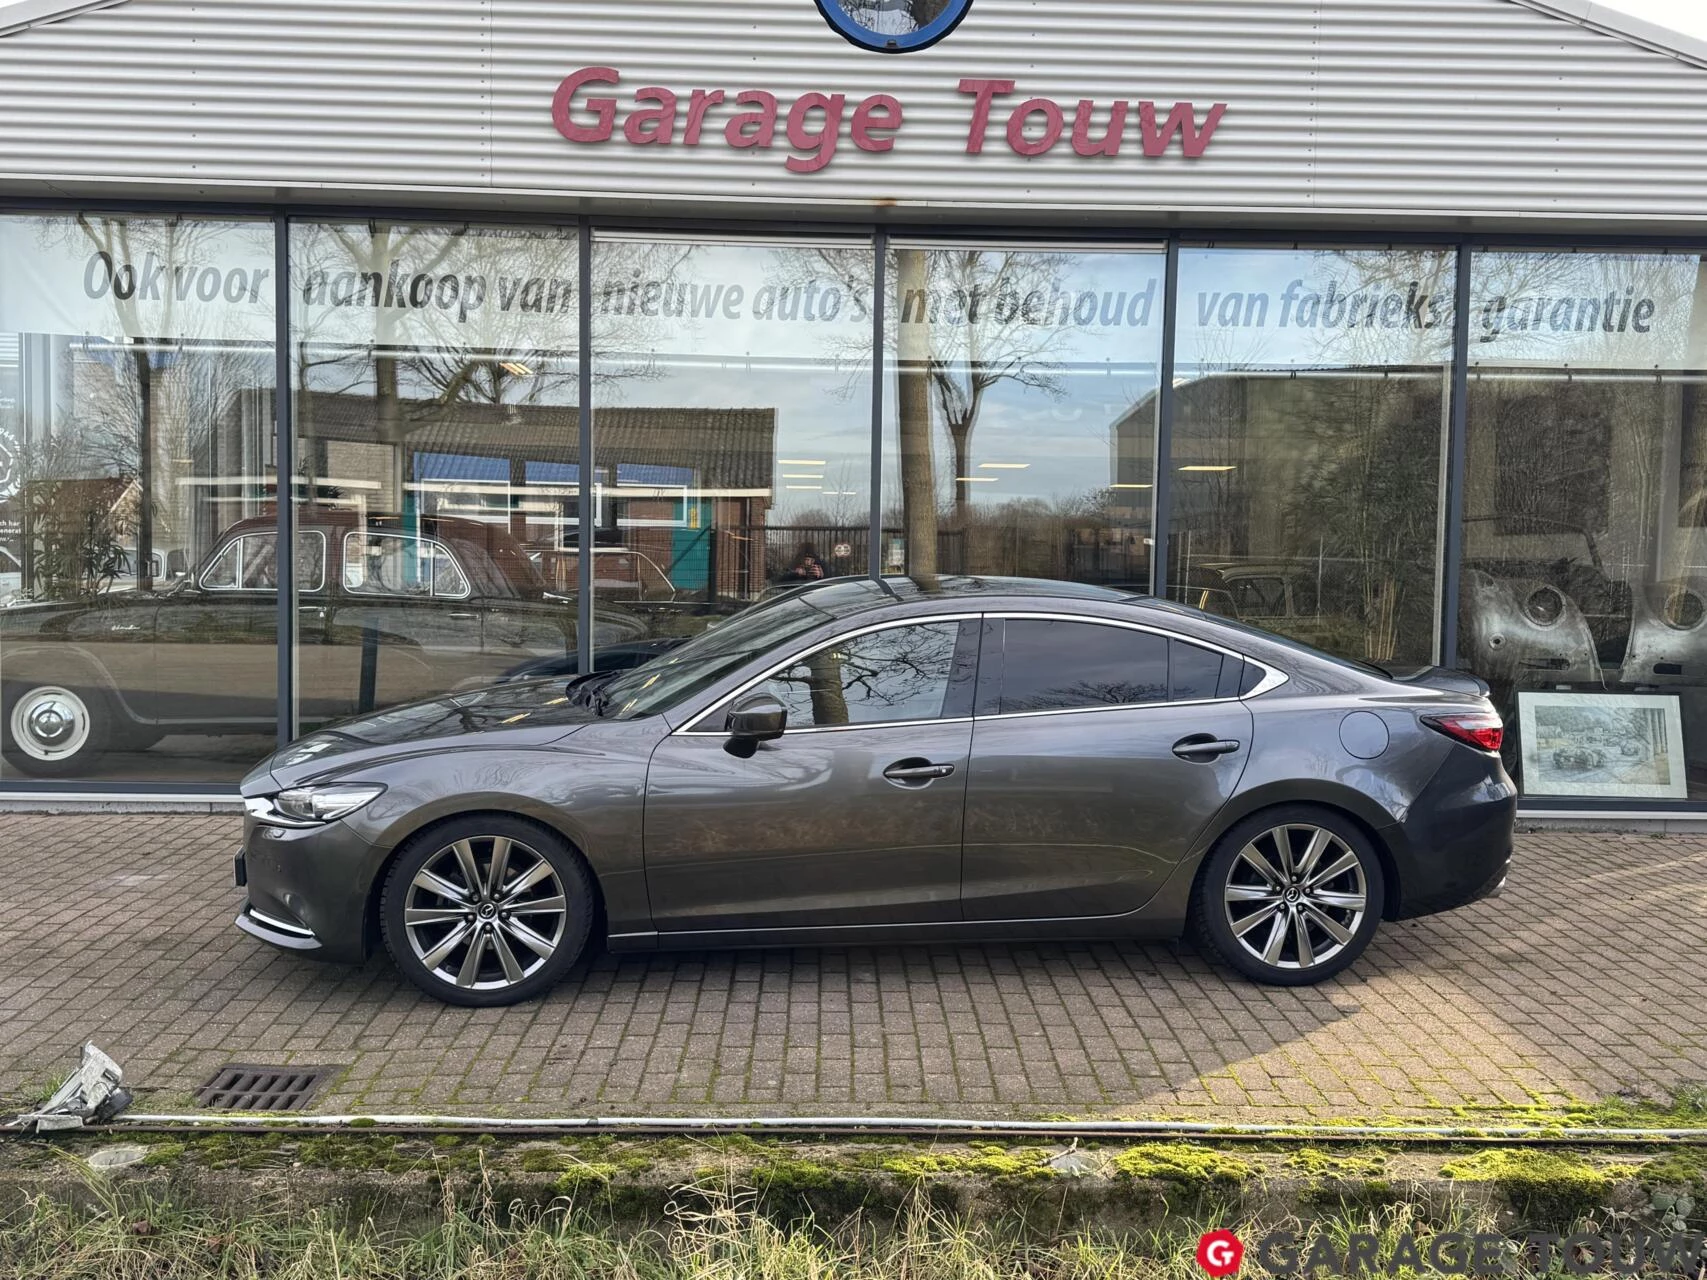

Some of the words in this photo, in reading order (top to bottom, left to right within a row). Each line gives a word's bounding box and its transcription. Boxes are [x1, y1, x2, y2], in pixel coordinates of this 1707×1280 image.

[552, 66, 903, 174] Garage
[958, 78, 1228, 158] Touw
[83, 250, 166, 301] Ook
[174, 265, 270, 304] voor
[303, 259, 487, 323] aankoop
[498, 275, 573, 314] van
[600, 267, 745, 320] nieuwe
[752, 275, 869, 322] auto's
[900, 283, 988, 327] met
[994, 277, 1158, 327] behoud
[1197, 291, 1270, 328] van
[1479, 285, 1655, 343] garantie
